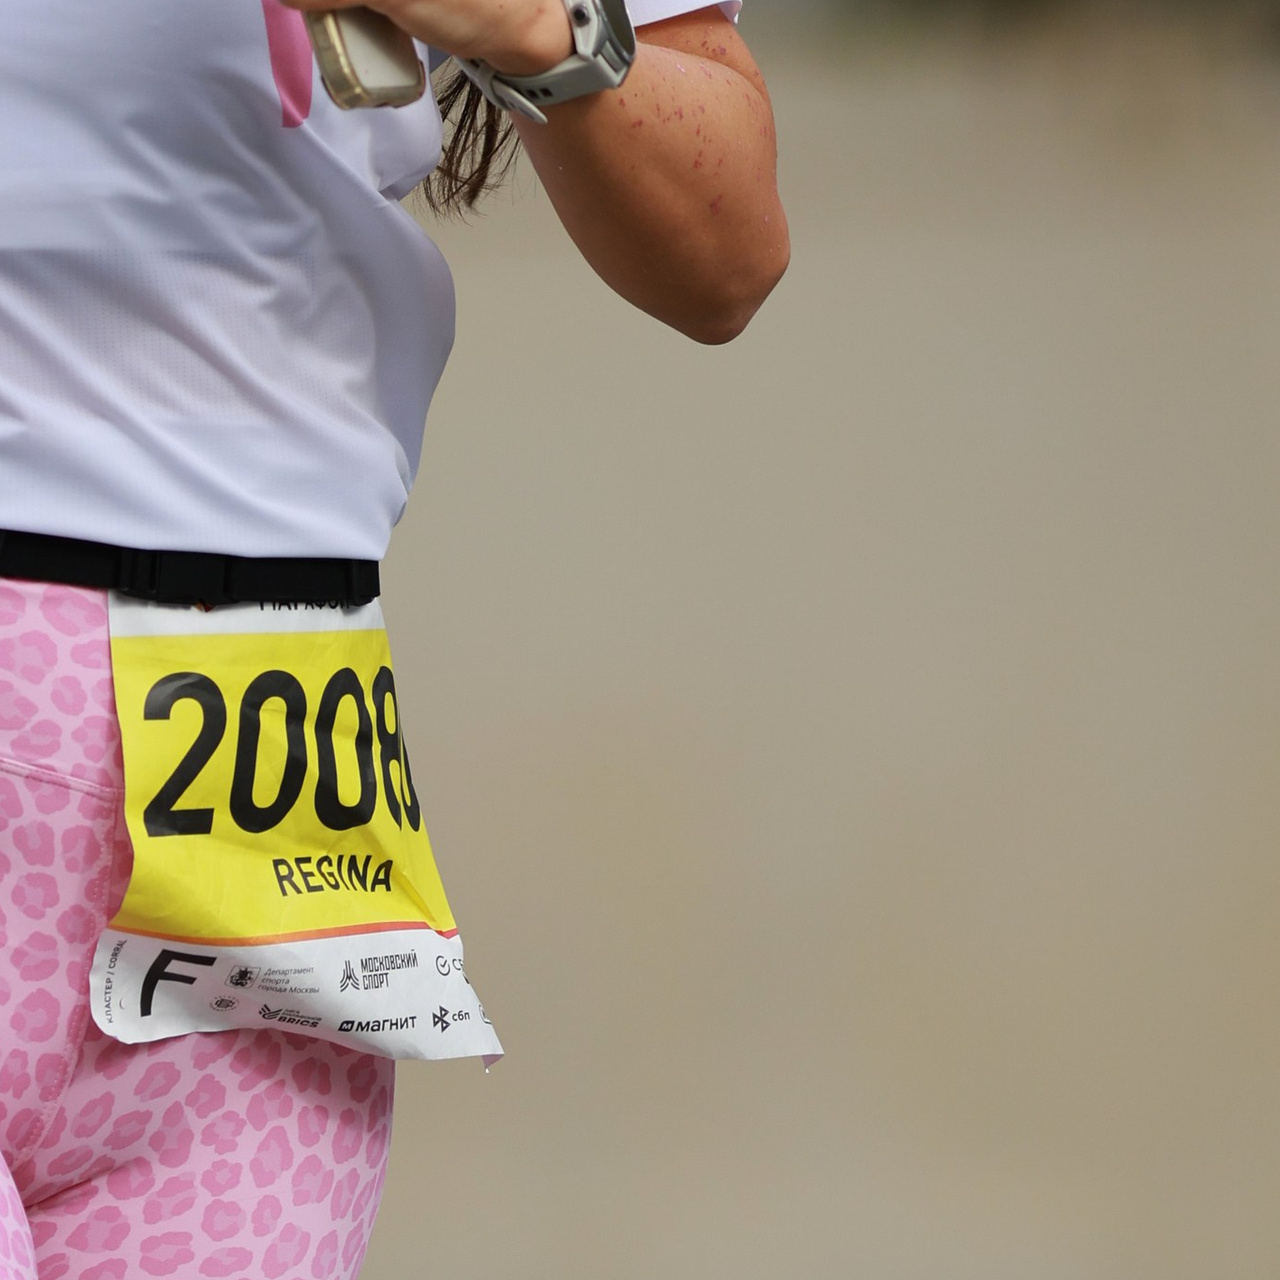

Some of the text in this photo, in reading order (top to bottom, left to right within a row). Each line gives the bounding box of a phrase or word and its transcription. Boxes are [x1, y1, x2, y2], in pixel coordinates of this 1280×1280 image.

[272, 854, 394, 897] REGINA
[264, 967, 315, 977] Департамент
[360, 949, 419, 974] МОСКОВСКИЙ
[140, 948, 218, 1018] F
[362, 972, 389, 990] СПОРТ
[104, 977, 114, 1024] КЛАСТЕР
[277, 1016, 320, 1028] BRICS
